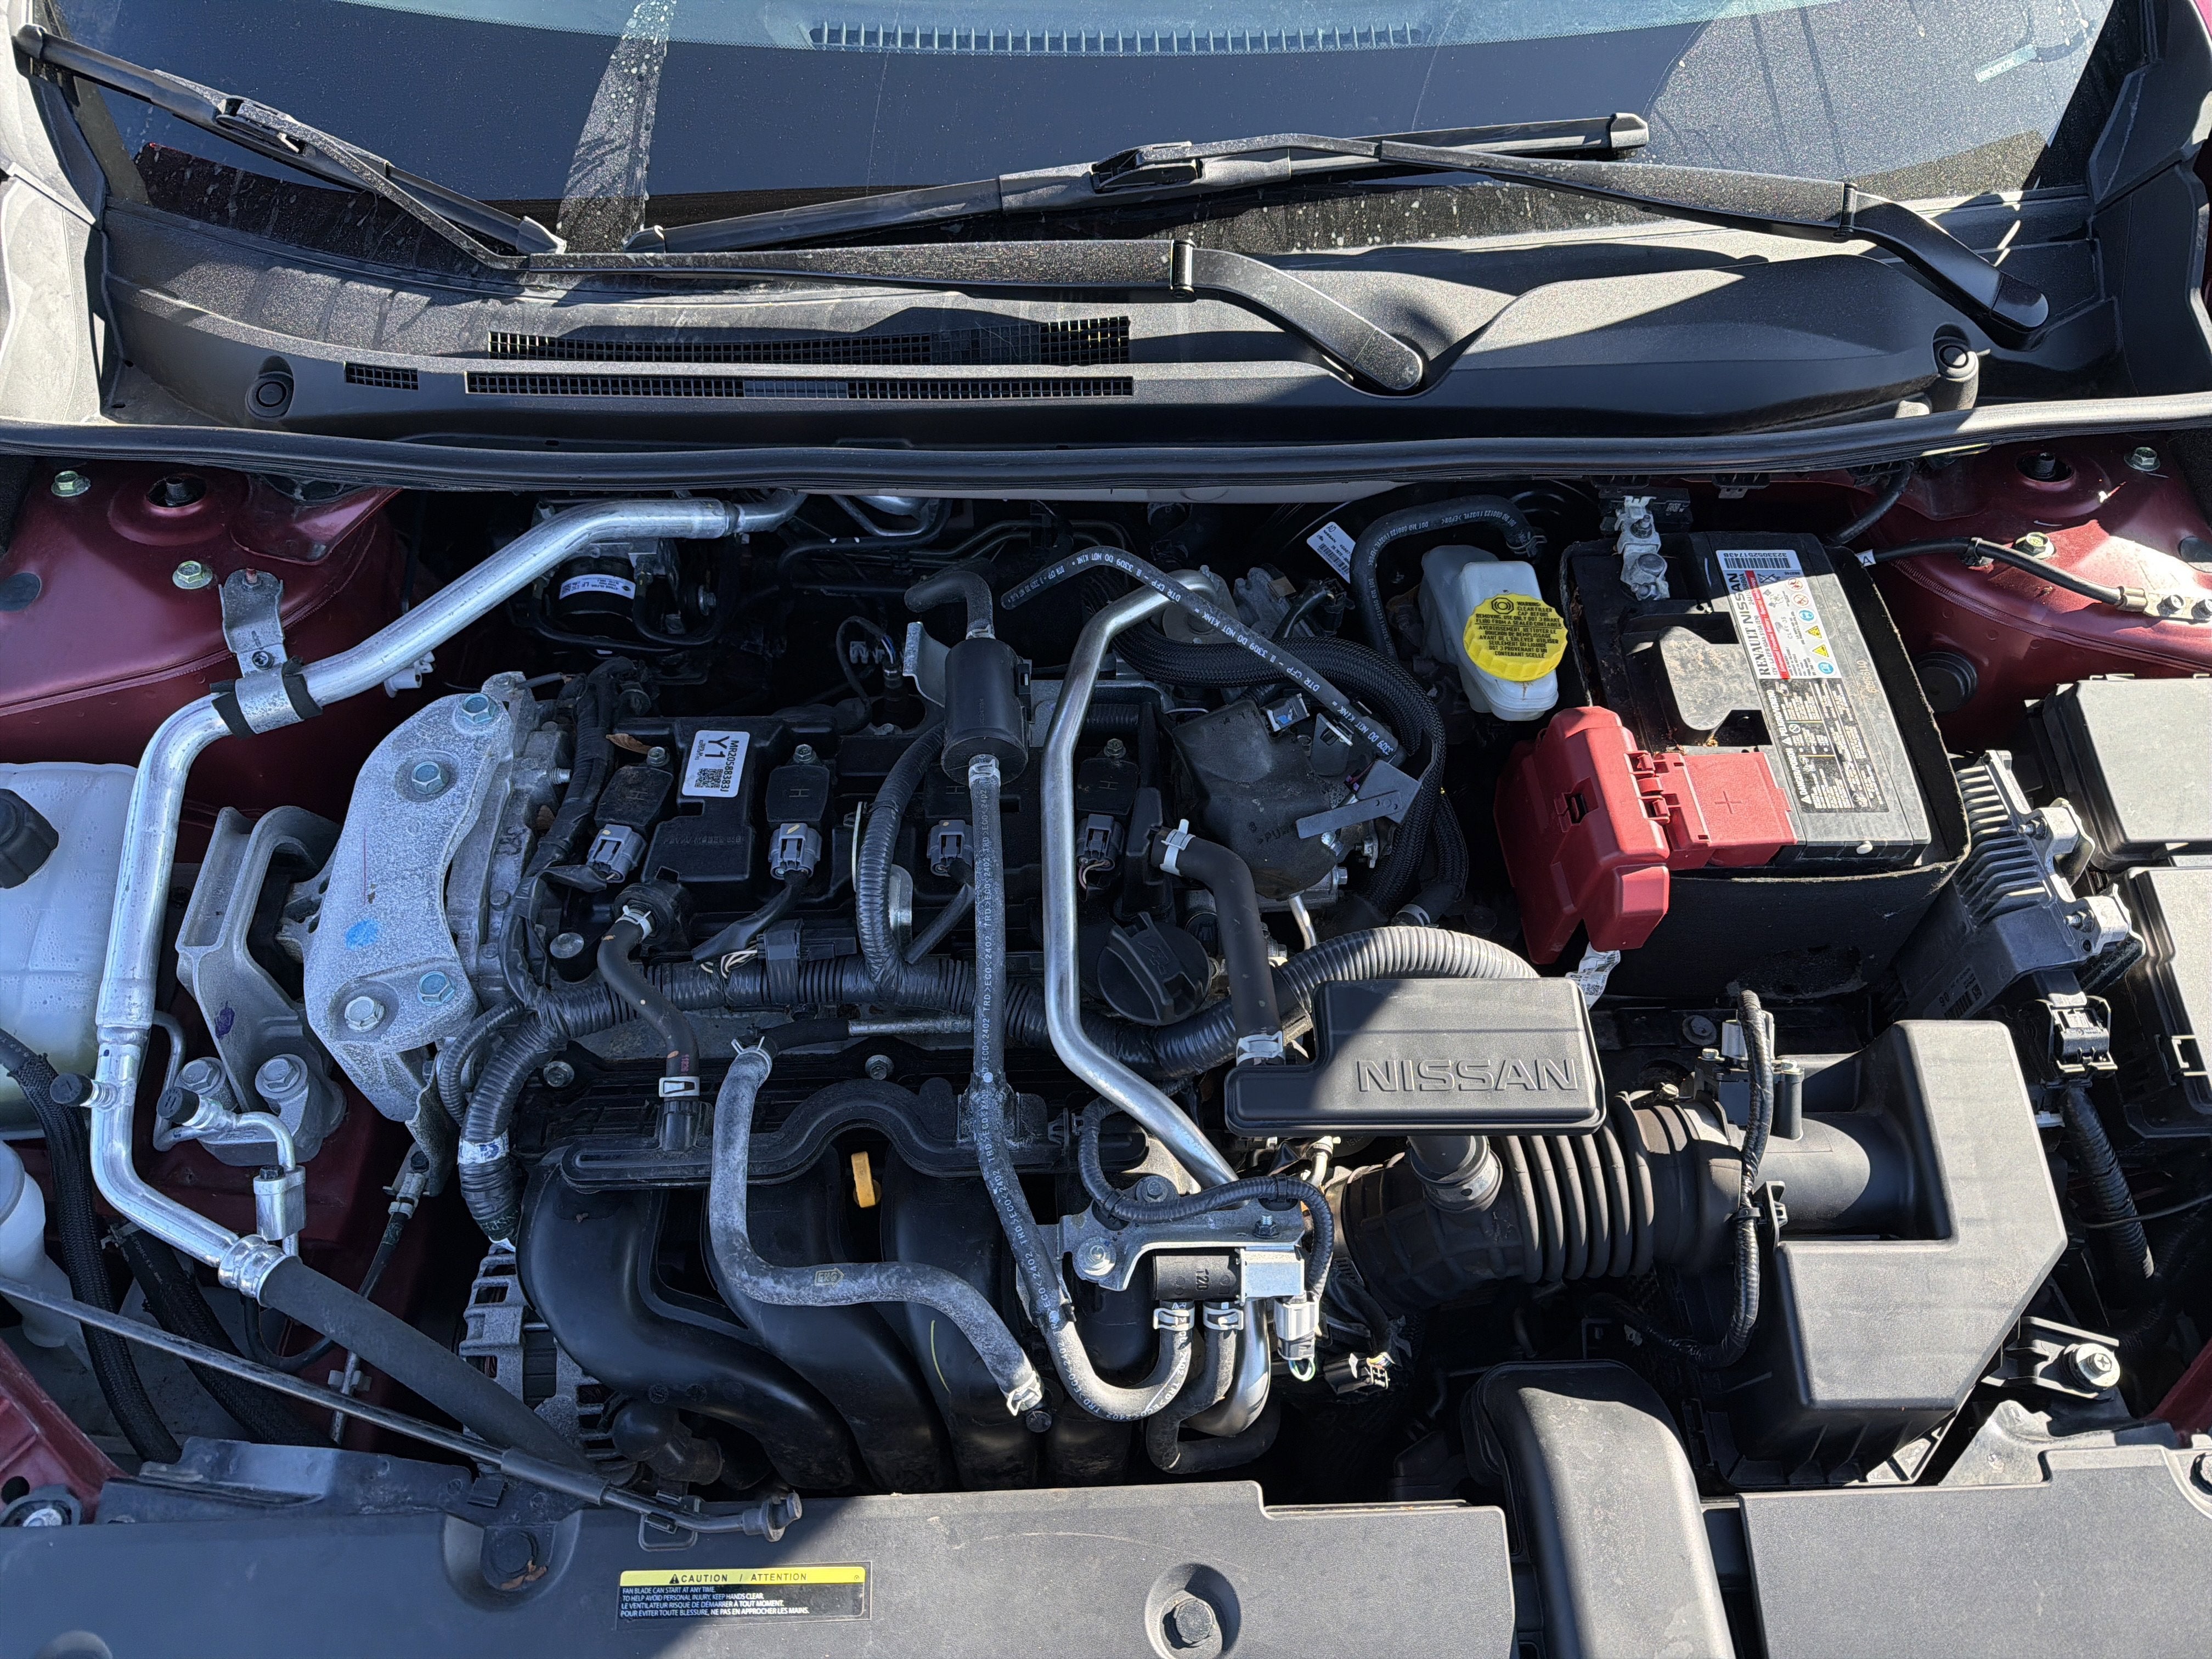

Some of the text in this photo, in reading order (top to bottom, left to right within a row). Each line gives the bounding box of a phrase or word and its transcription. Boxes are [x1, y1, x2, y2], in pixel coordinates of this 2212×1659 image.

[1091, 552, 1102, 561] NOT
[1104, 553, 1114, 563] DO
[1116, 558, 1134, 573] 3309
[1863, 556, 1874, 566] A
[1152, 580, 1165, 592] CFP
[1167, 588, 1181, 602] DTR
[1727, 573, 1771, 675] RENAULT NISSAN
[1202, 611, 1321, 692] DTR CFP 3309 DO NOT KINK
[1767, 690, 1789, 737] PELIGRO/VENENO
[1338, 706, 1395, 755] 3309 DO NOT KINK
[720, 741, 739, 792] MR20588383J
[1785, 748, 1808, 795] DANGER/POISON
[1357, 1059, 1578, 1092] NISSAN
[817, 1272, 837, 1283] ENG
[1196, 1268, 1209, 1291] 120
[681, 1574, 728, 1583] CAUTION
[751, 1573, 806, 1581] ATTENTION
